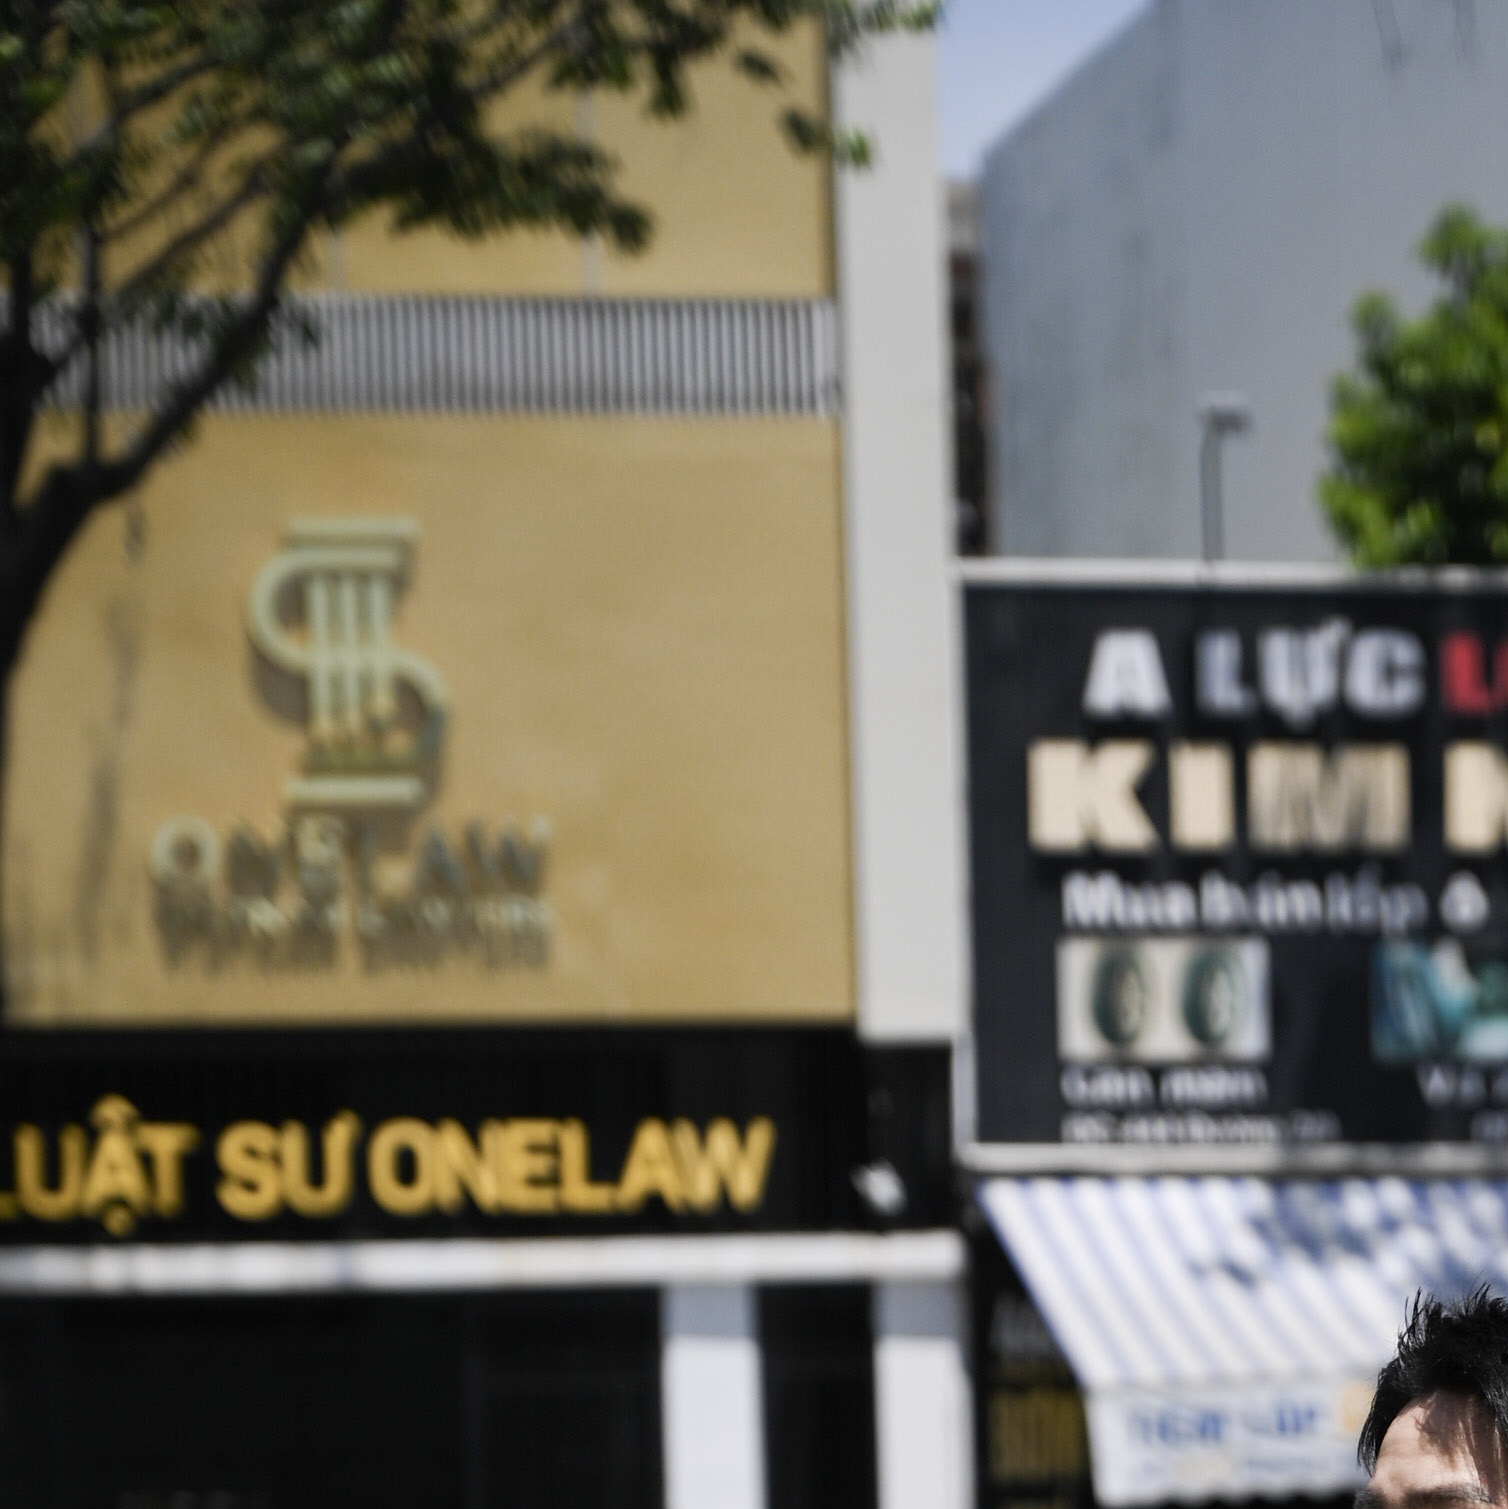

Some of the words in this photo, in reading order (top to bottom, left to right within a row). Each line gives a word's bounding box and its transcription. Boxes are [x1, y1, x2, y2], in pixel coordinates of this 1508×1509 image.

[1084, 627, 1172, 717] A
[1025, 738, 1412, 856] KIM
[1061, 870, 1200, 932] Mua
[215, 1109, 363, 1221] SƯ
[367, 1113, 777, 1219] ONELAW
